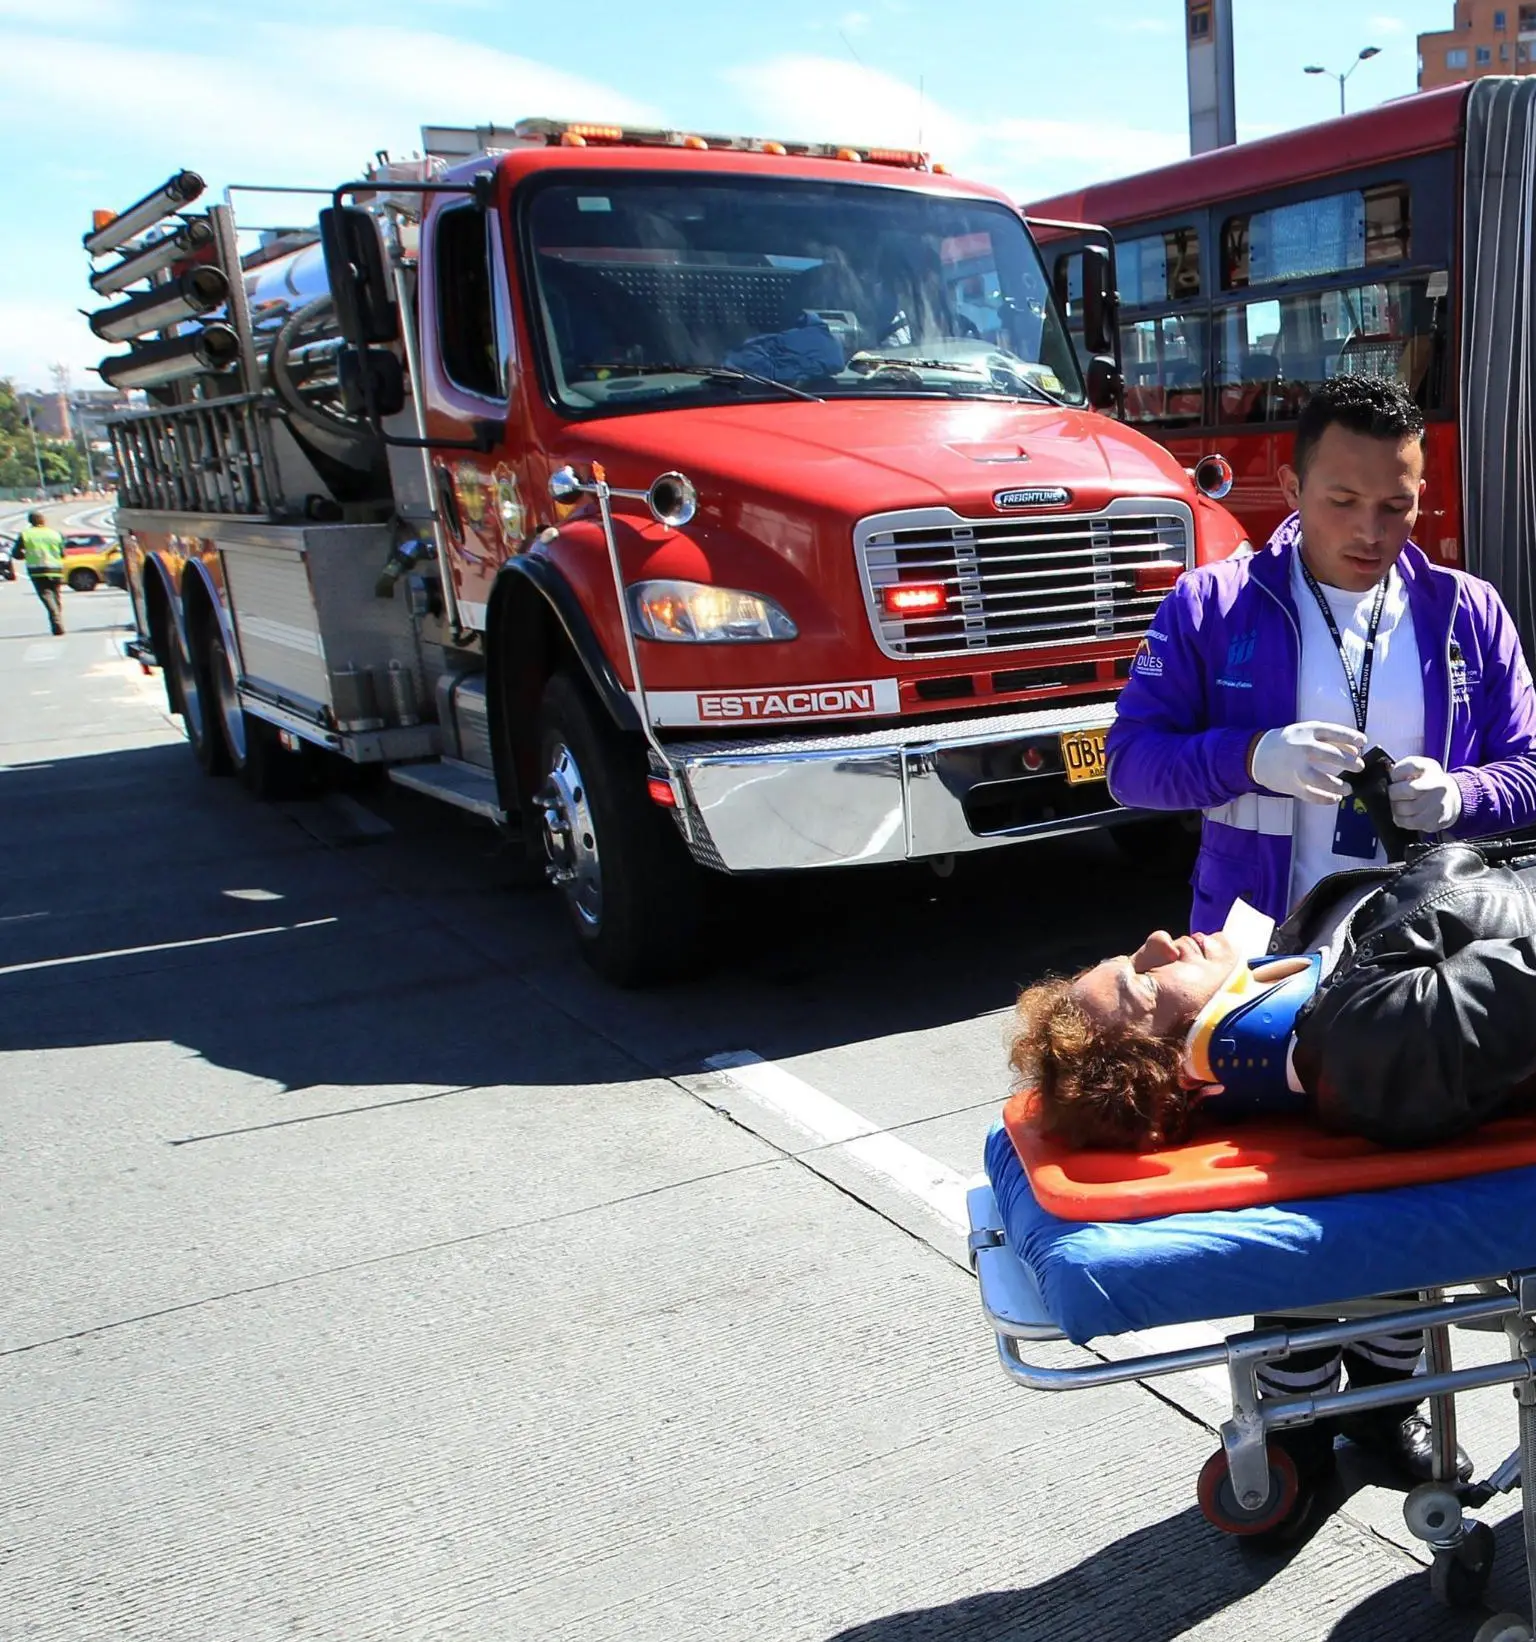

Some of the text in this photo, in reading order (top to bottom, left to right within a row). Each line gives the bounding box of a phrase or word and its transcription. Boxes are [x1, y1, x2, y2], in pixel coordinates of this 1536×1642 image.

[1003, 491, 1066, 504] FREIGHTLINE
[1137, 654, 1163, 669] DUES
[701, 689, 870, 717] ESTACION
